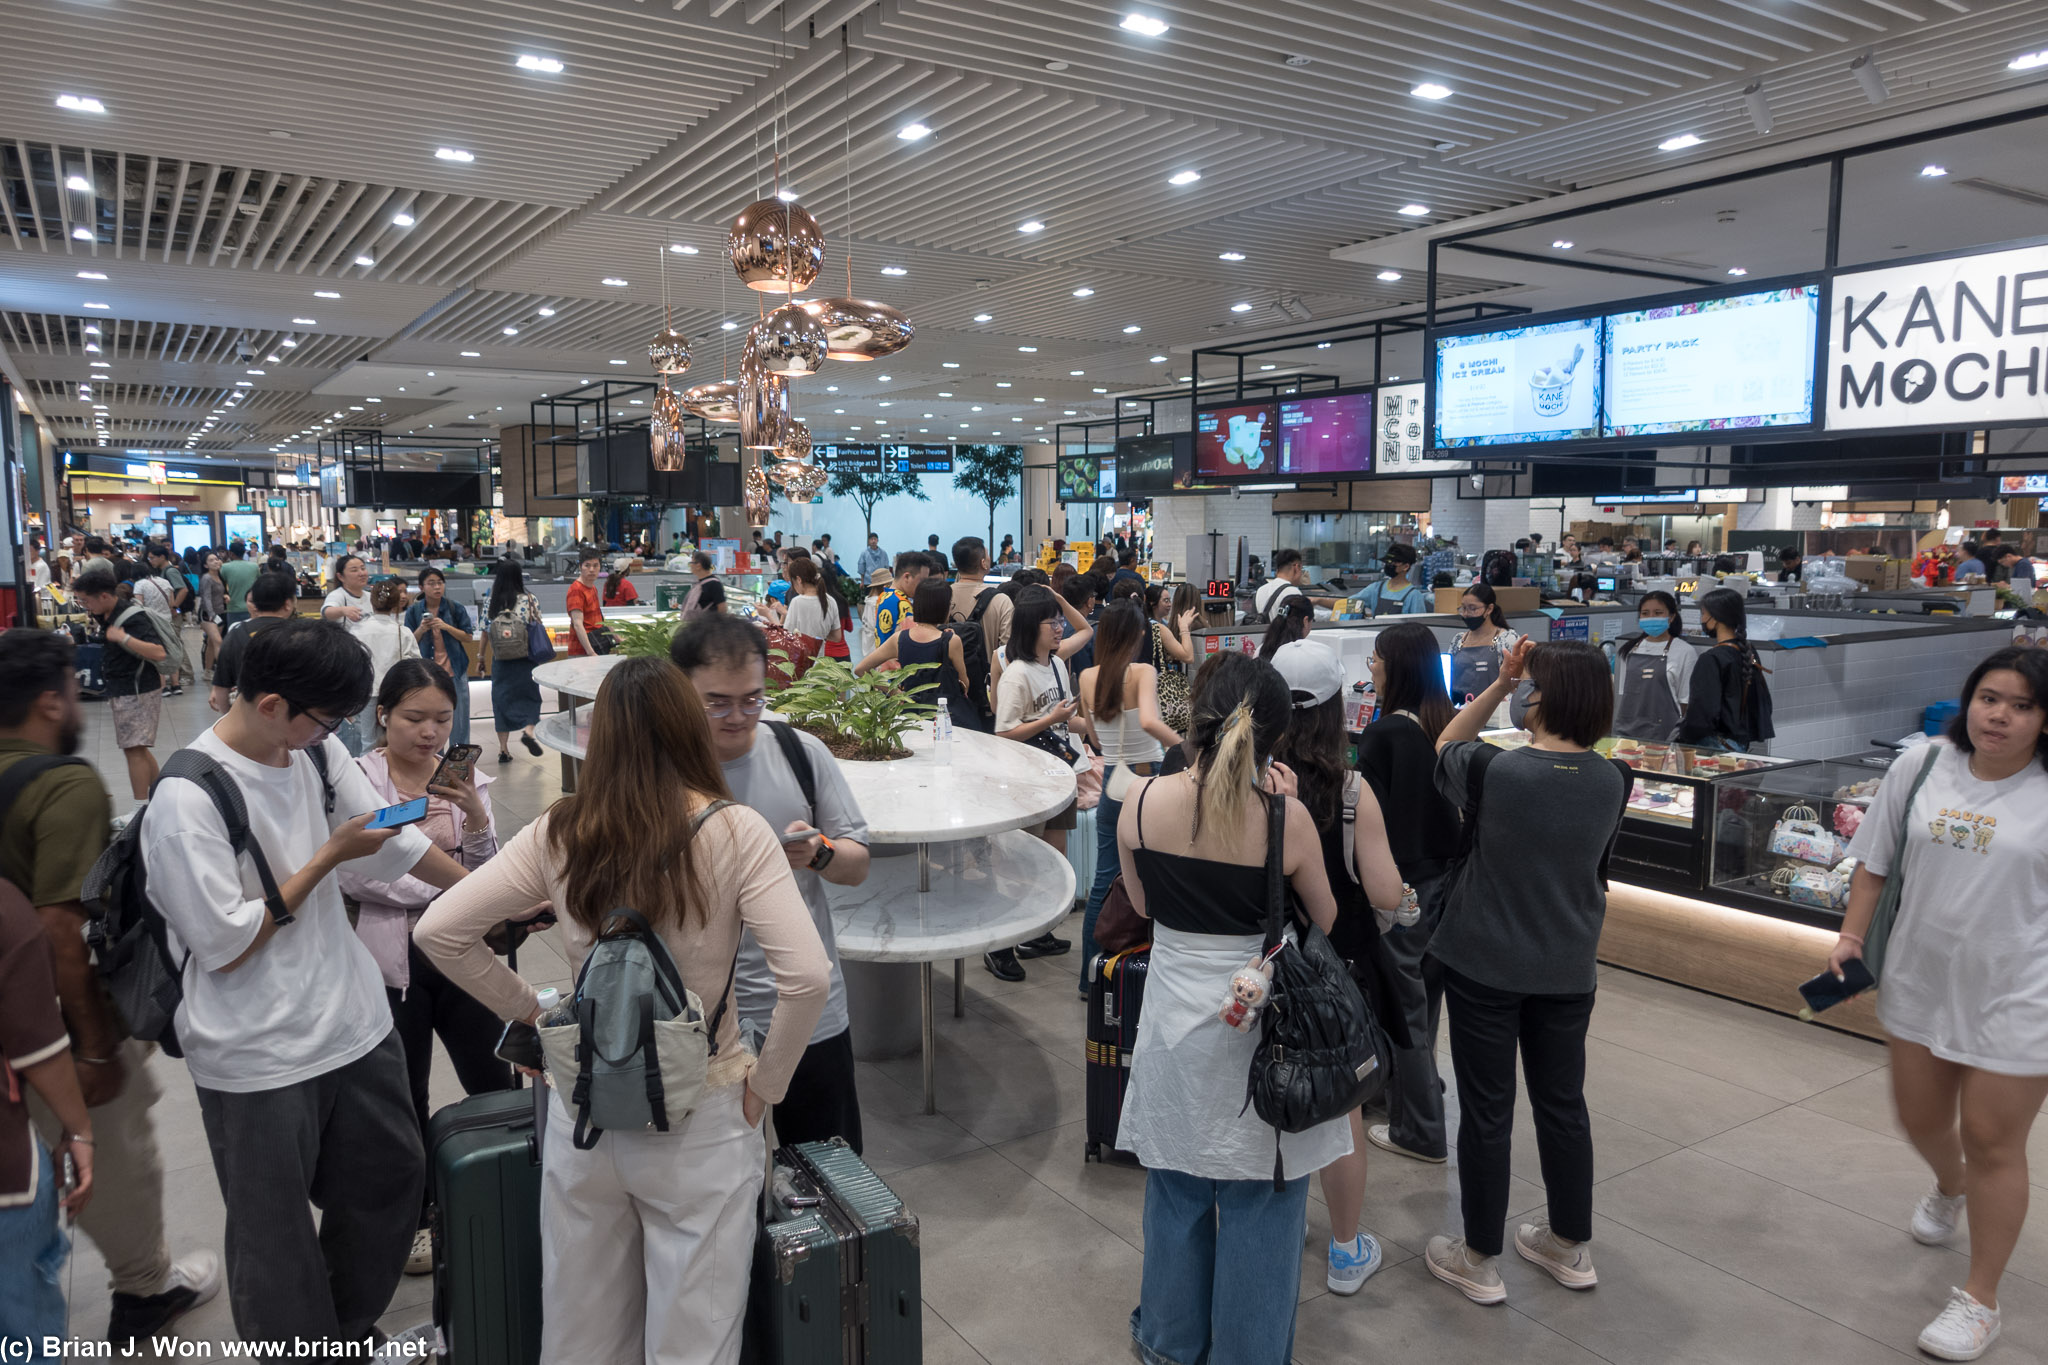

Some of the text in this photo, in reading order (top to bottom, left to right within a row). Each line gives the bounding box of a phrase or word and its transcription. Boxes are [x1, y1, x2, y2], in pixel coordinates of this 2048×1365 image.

[1842, 269, 2048, 354] KANE
[1622, 338, 1699, 355] PARTY PACK
[1468, 358, 1498, 368] MOCHI
[1452, 366, 1506, 379] ICE CREAM
[1538, 391, 1564, 402] KANE
[1208, 581, 1230, 597] 012
[1552, 620, 1566, 629] CPR
